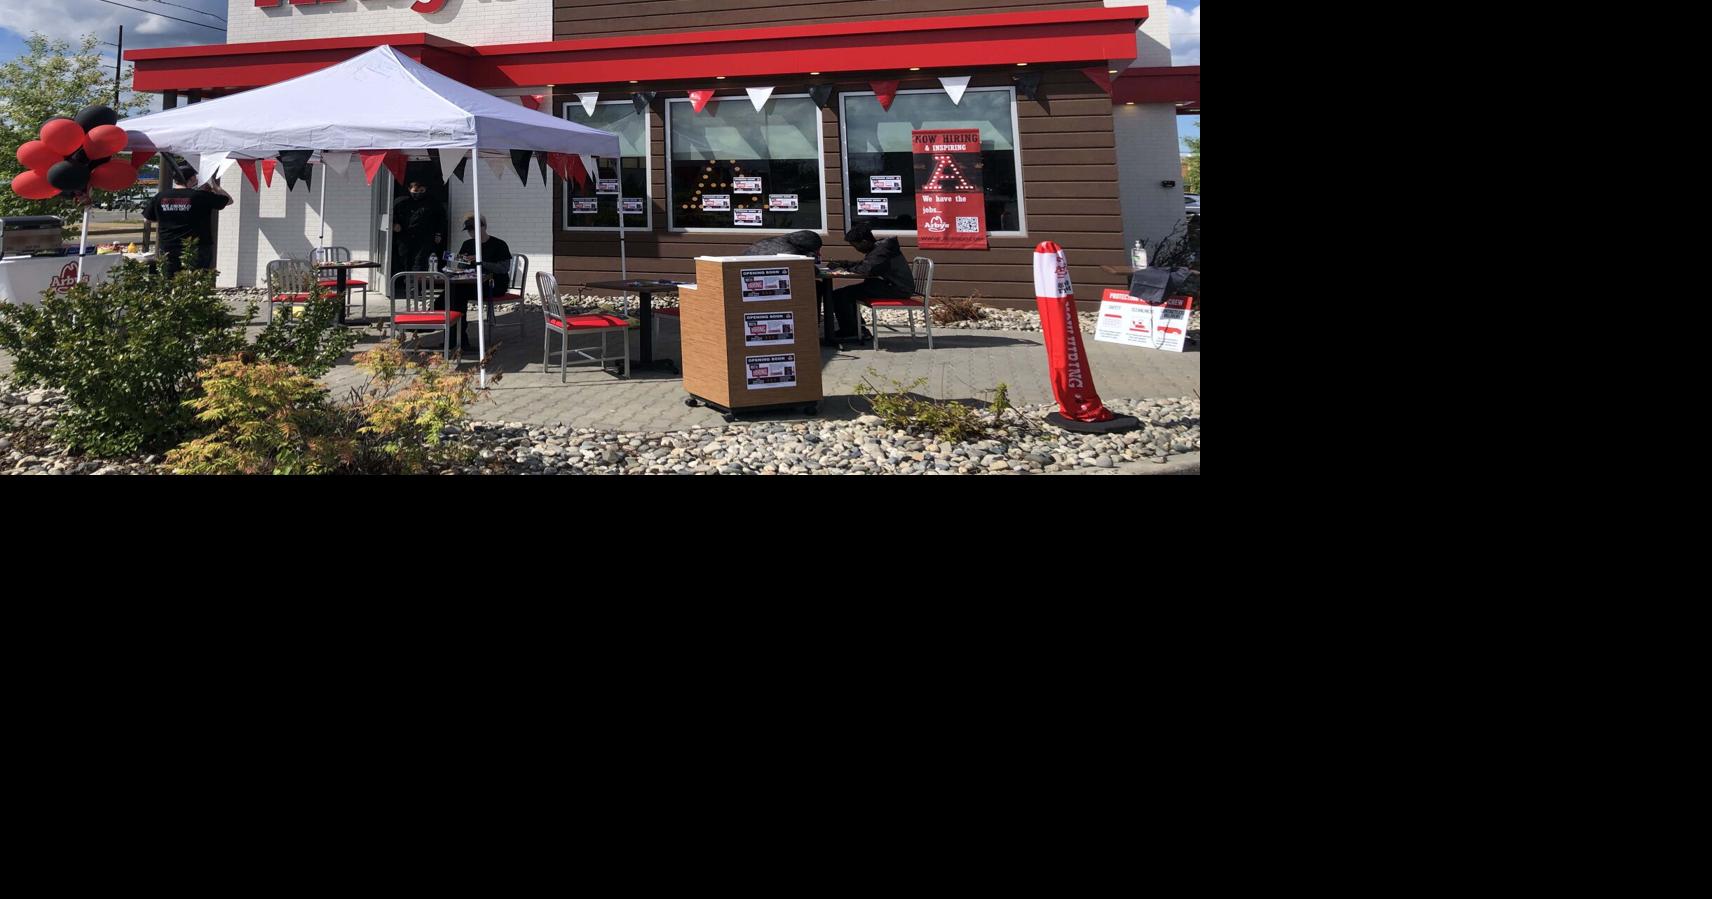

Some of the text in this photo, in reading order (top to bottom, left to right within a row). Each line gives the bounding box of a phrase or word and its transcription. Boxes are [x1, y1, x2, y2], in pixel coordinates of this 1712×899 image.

[914, 133, 978, 143] NOW HIRING
[921, 153, 976, 192] A
[50, 272, 90, 288] Arb's
[1167, 297, 1185, 306] CREW
